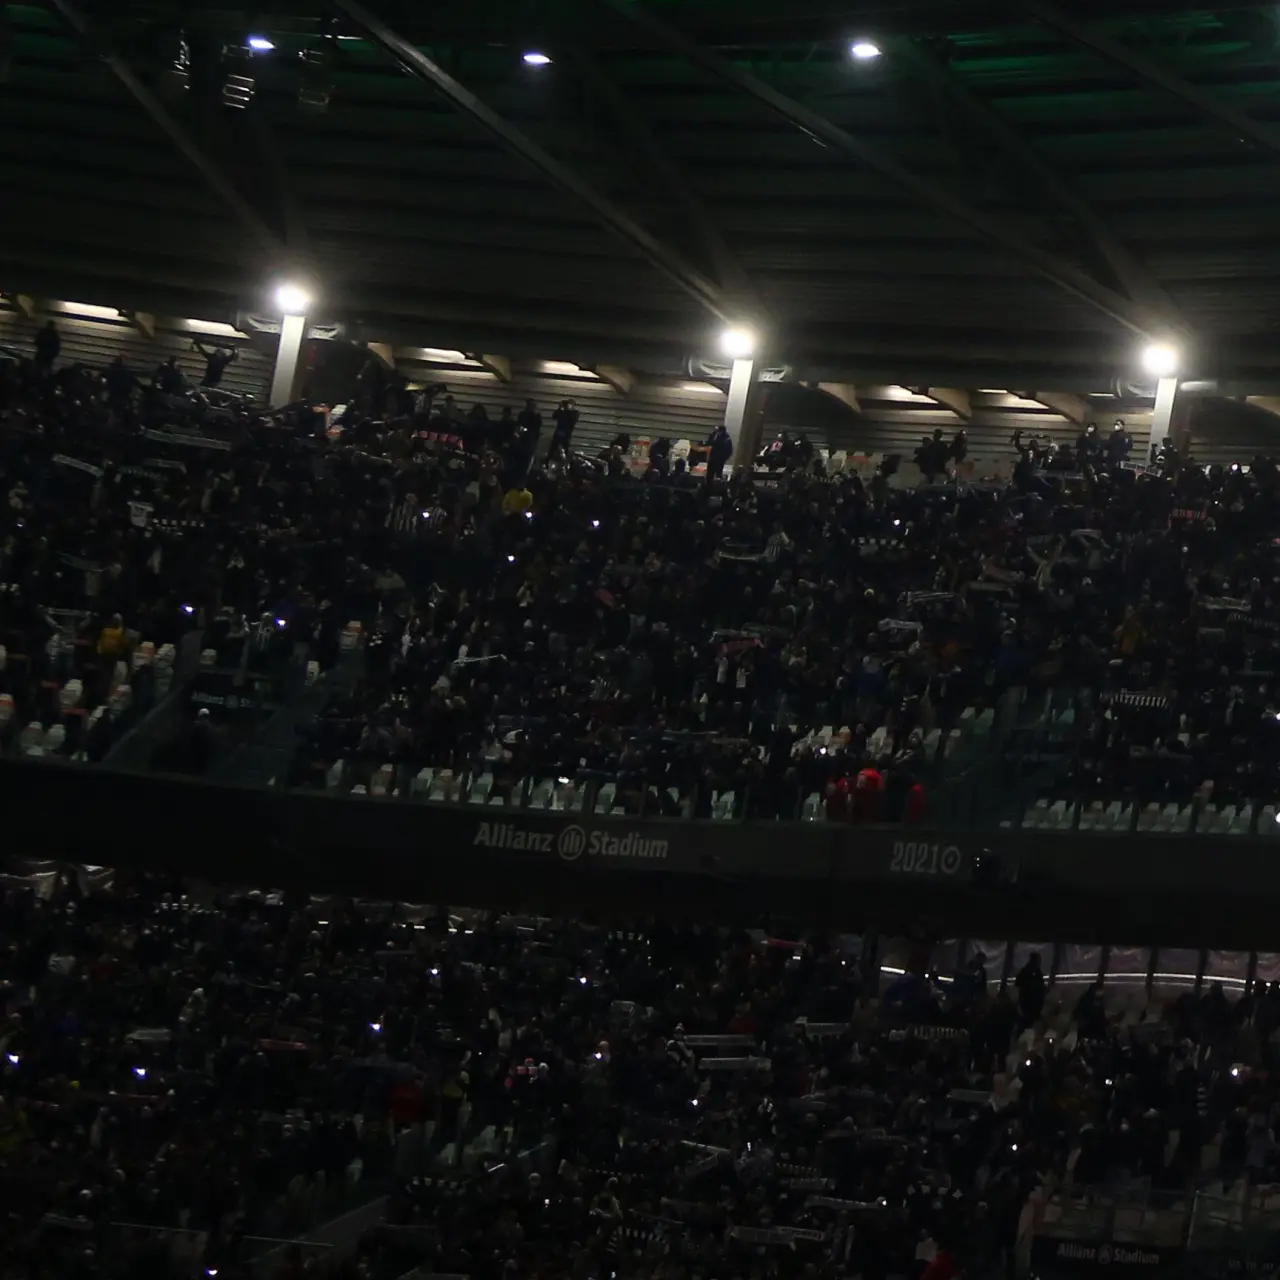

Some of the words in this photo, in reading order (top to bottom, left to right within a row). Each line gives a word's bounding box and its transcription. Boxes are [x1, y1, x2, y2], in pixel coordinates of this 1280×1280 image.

[472, 821, 555, 852] Allianz
[588, 830, 669, 859] Stadium
[889, 840, 940, 874] 2021
[1057, 1242, 1097, 1262] Allianz
[1113, 1247, 1160, 1266] Stadium
